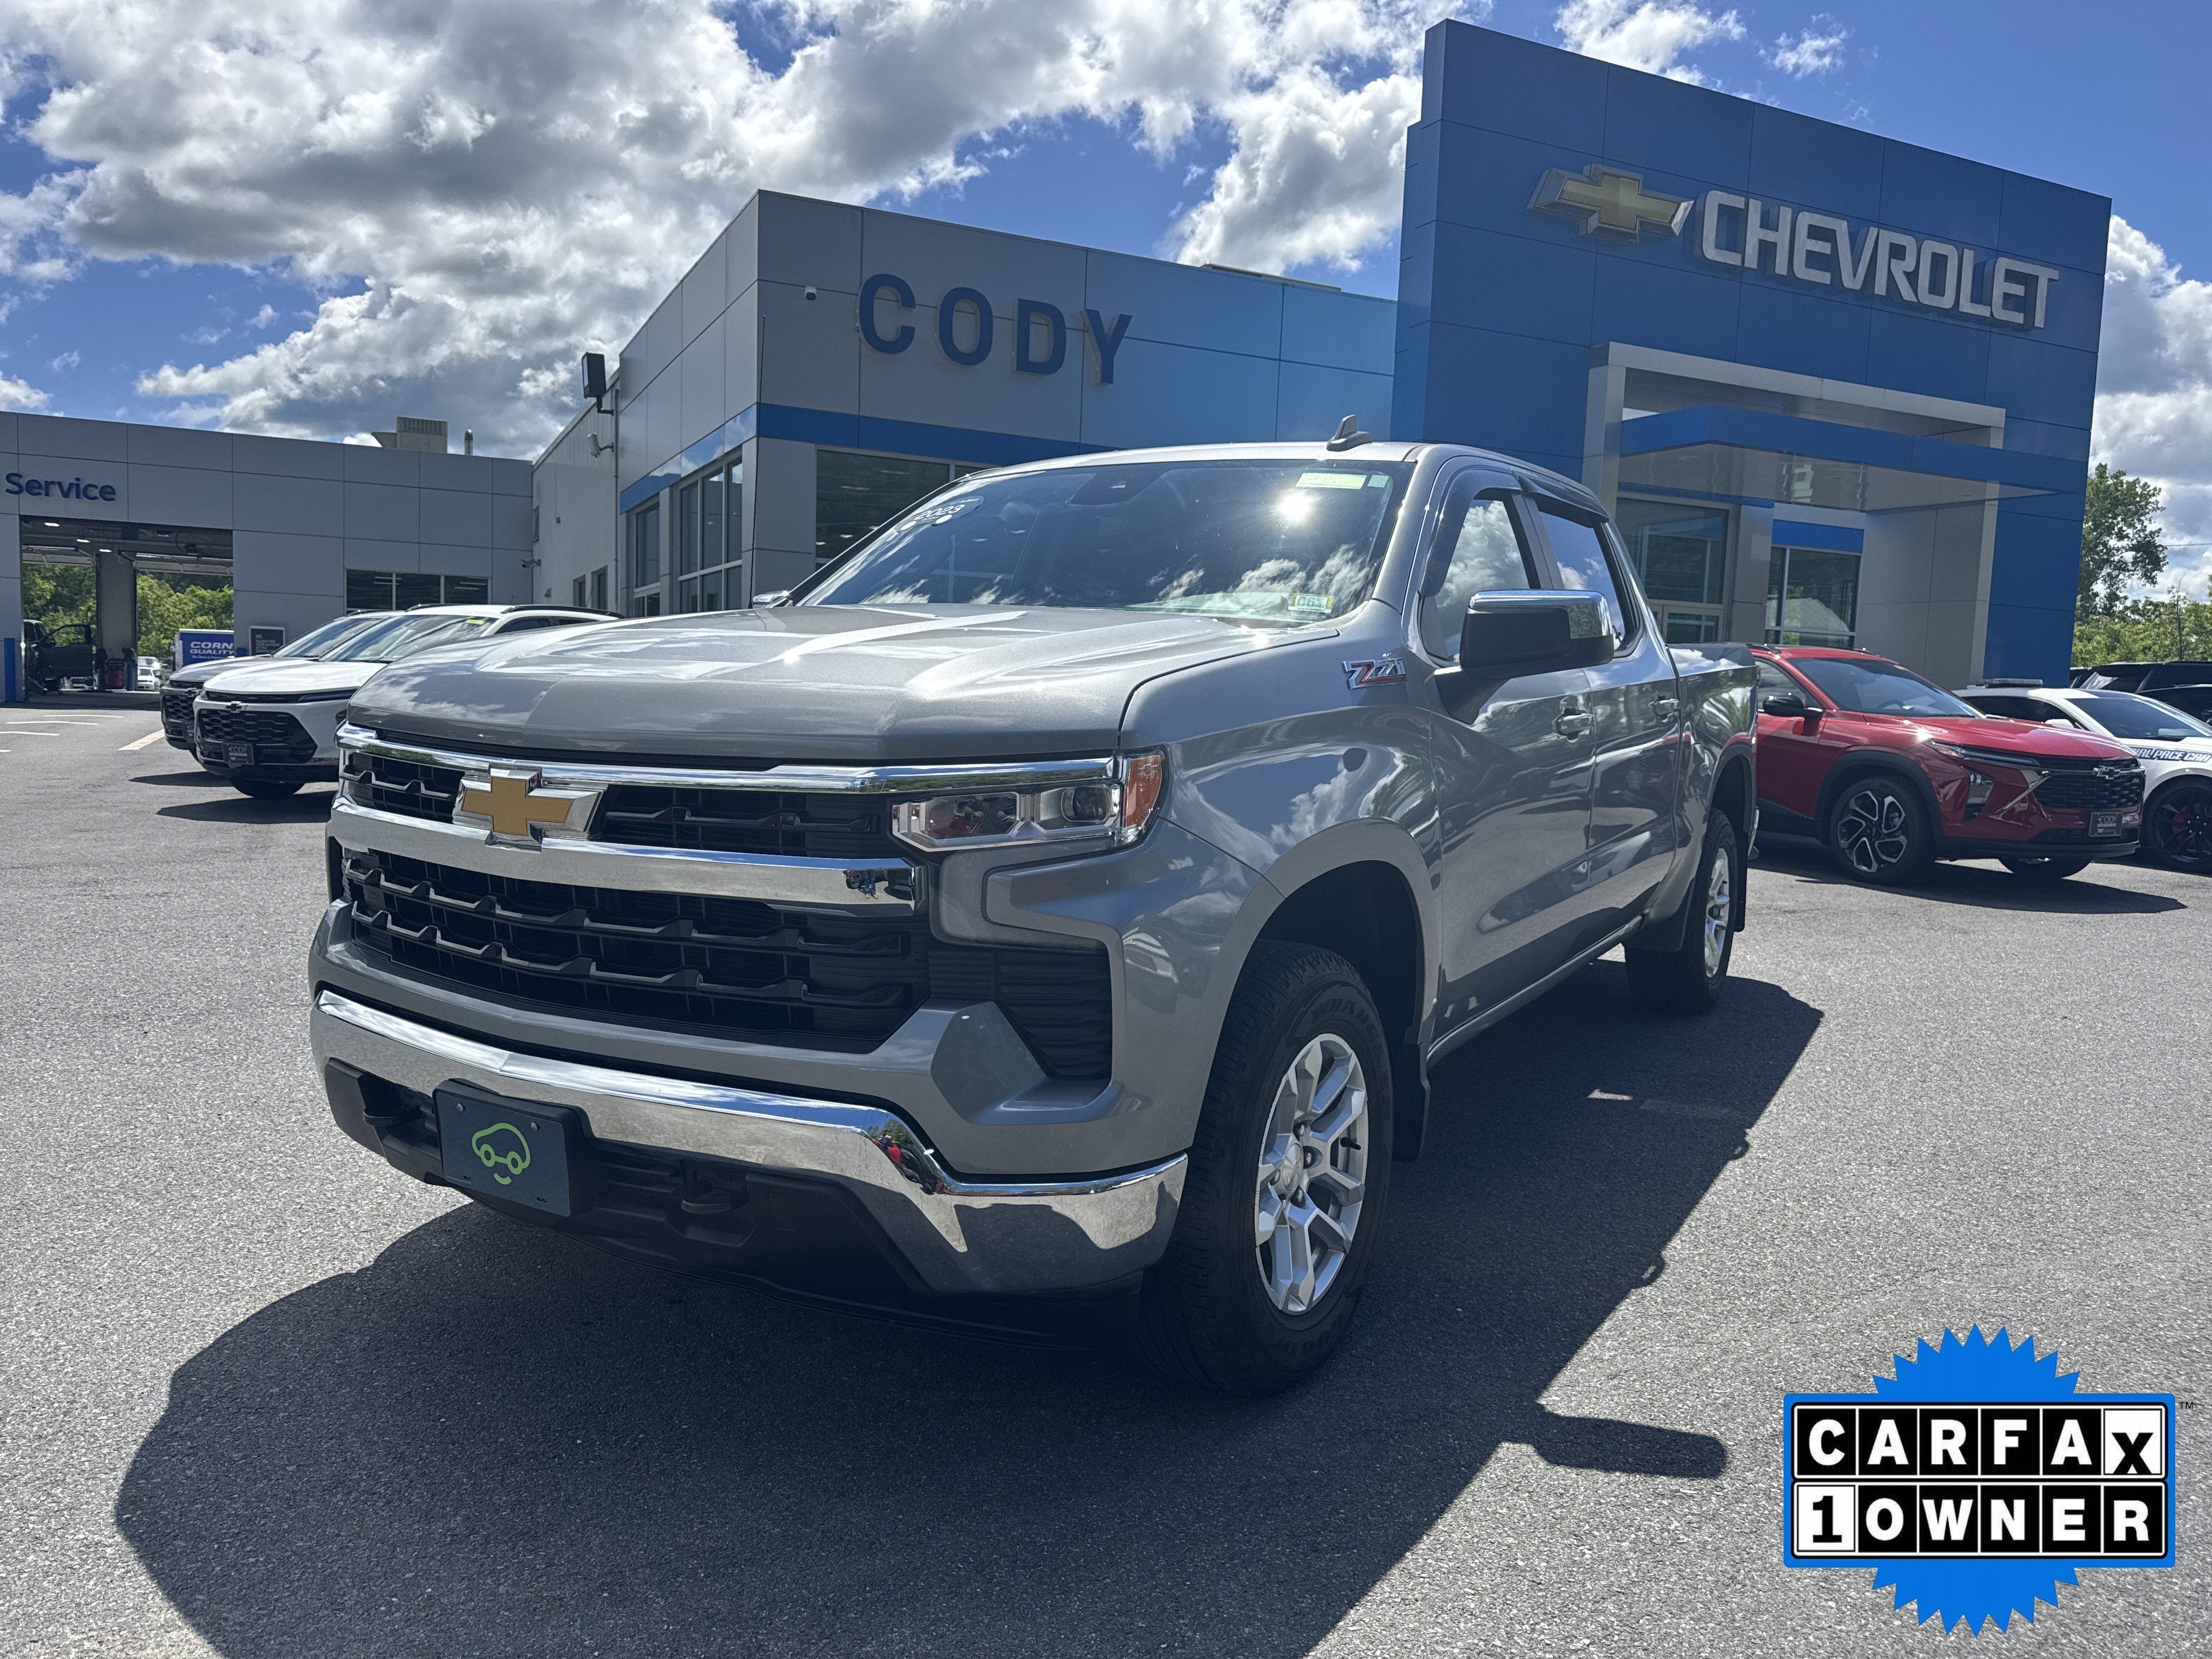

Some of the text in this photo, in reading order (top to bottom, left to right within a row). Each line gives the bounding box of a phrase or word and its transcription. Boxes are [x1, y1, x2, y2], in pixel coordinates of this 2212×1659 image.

[1701, 189, 2059, 328] CHEVROLET
[858, 273, 1133, 385] CODY
[5, 472, 116, 501] Service
[913, 504, 966, 521] 2023
[190, 641, 234, 650] CORN
[1342, 658, 1407, 690] Z71
[2152, 749, 2185, 760] PACE
[2183, 752, 2212, 761] CAR
[2098, 815, 2118, 823] CODY
